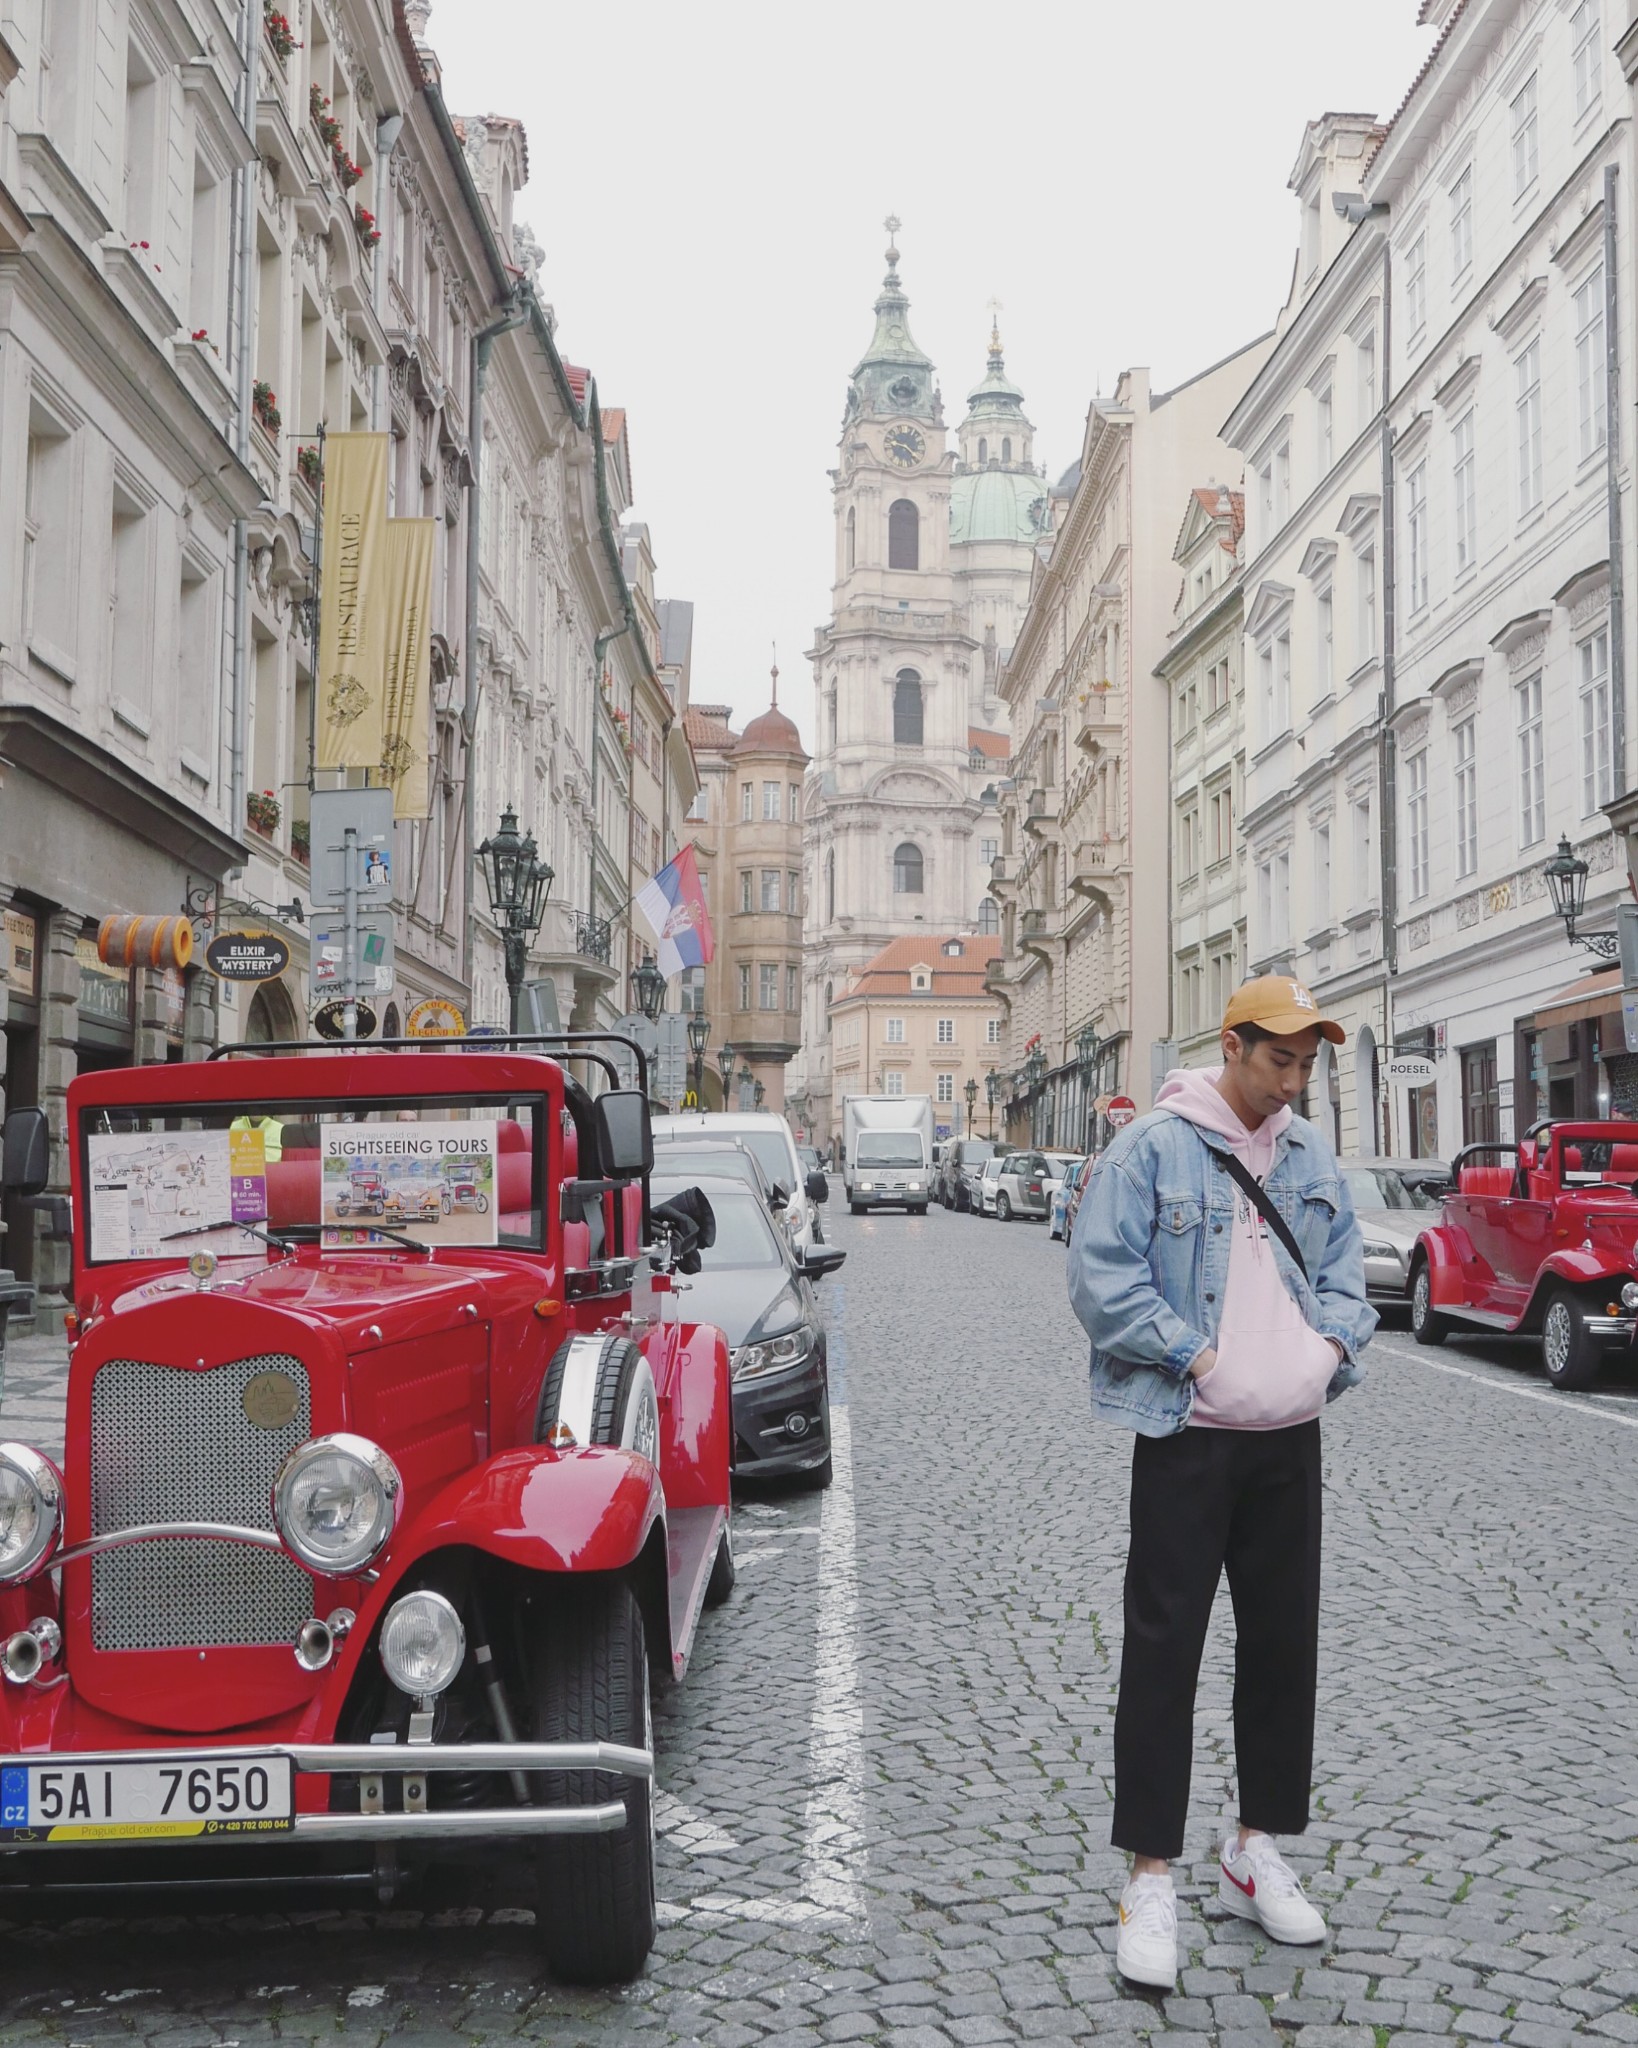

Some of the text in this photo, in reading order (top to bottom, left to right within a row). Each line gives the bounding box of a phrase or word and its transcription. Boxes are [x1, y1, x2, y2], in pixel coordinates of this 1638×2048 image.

[338, 513, 360, 656] RESTAURACE
[386, 649, 400, 719] RESIDENCE
[230, 946, 265, 956] ELIXIR
[222, 960, 273, 970] MYSTERY
[1289, 983, 1314, 1010] LA
[410, 1001, 463, 1026] PUB COCKTAIL
[1390, 1064, 1431, 1074] ROESEL
[241, 1132, 252, 1143] A
[356, 1131, 387, 1140] Prague
[389, 1131, 404, 1139] old
[329, 1139, 488, 1155] SIGHTSEEING TOURS
[243, 1179, 252, 1189] B
[159, 1766, 269, 1815] 7650
[4, 1806, 25, 1820] CZ
[81, 1824, 176, 1838] Prague old car.com
[226, 1821, 240, 1830] 420
[243, 1820, 256, 1830] 702
[258, 1820, 272, 1829] 000
[274, 1819, 289, 1828] 044
